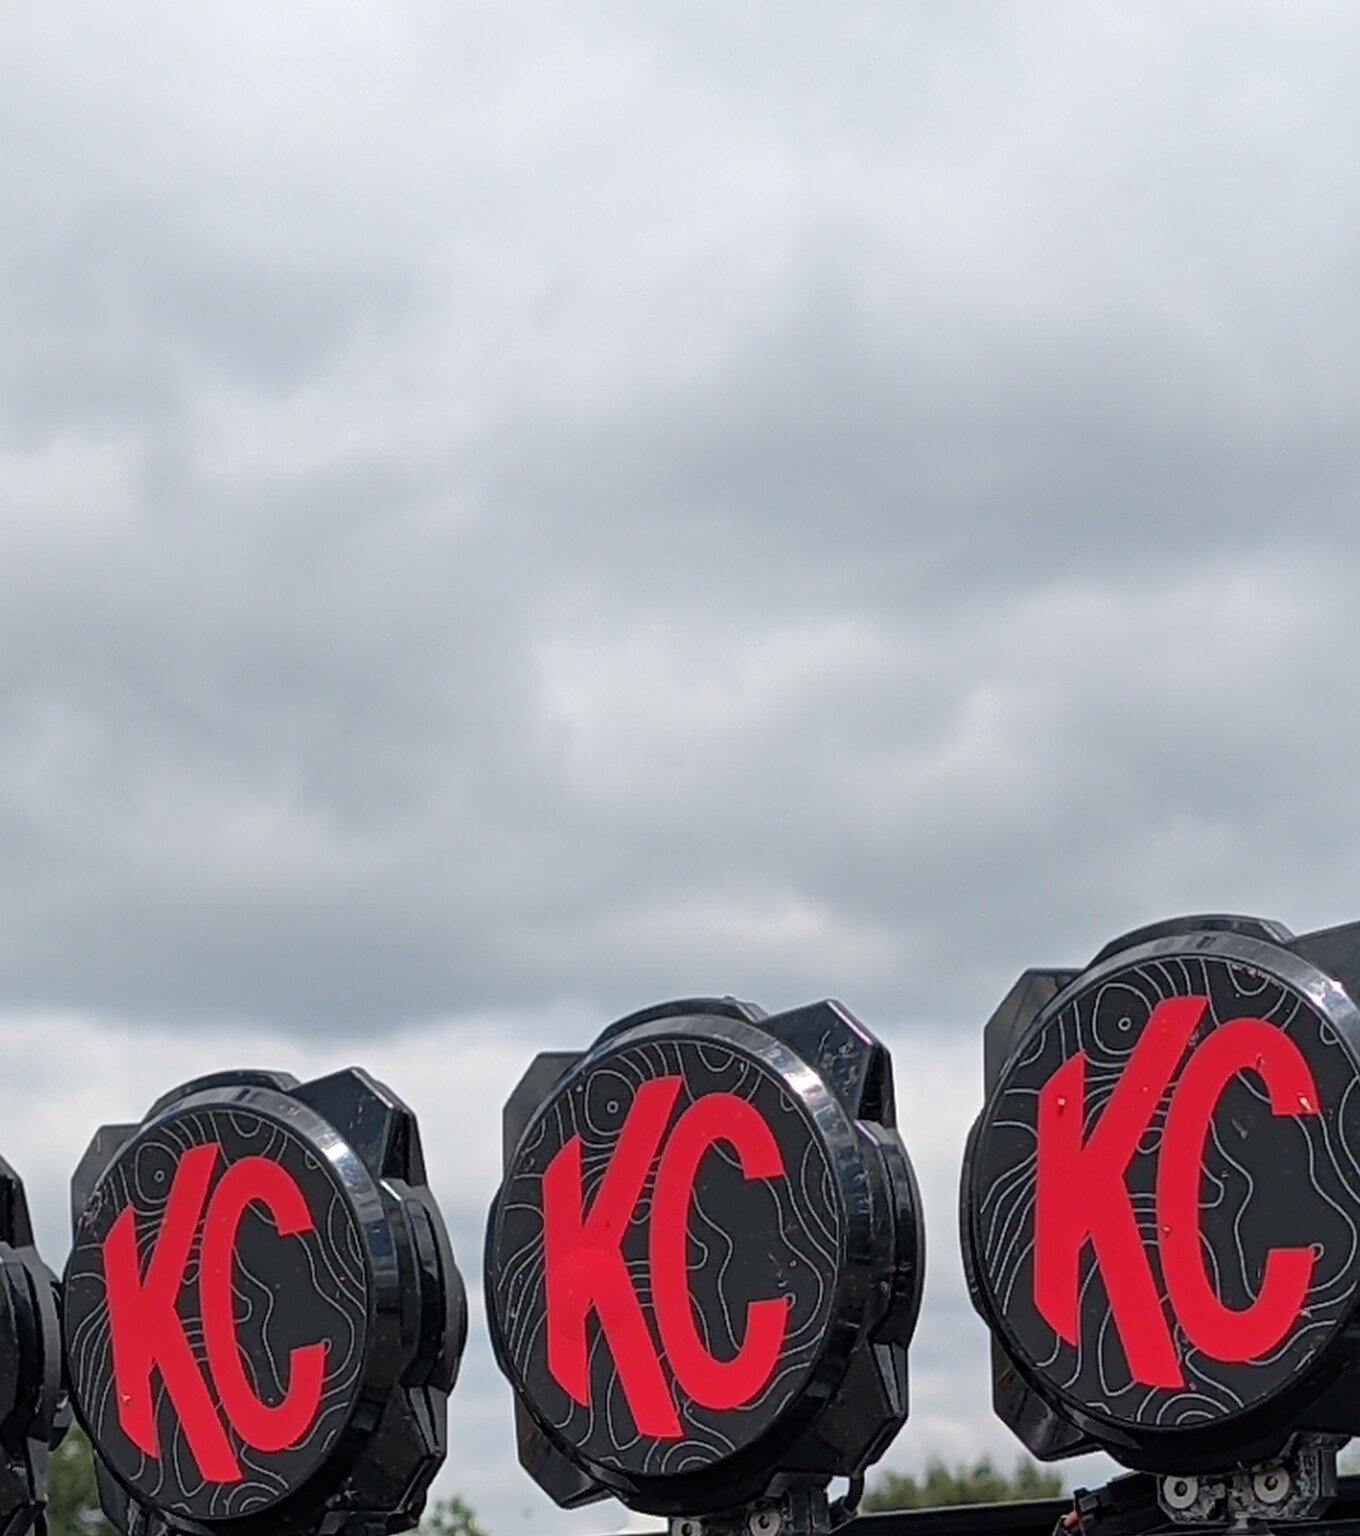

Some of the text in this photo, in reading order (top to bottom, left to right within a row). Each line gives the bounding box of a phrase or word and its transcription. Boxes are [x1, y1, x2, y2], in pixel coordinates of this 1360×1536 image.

[103, 1143, 328, 1482] KC
[543, 1076, 788, 1439] KC
[1034, 996, 1319, 1388] KC
